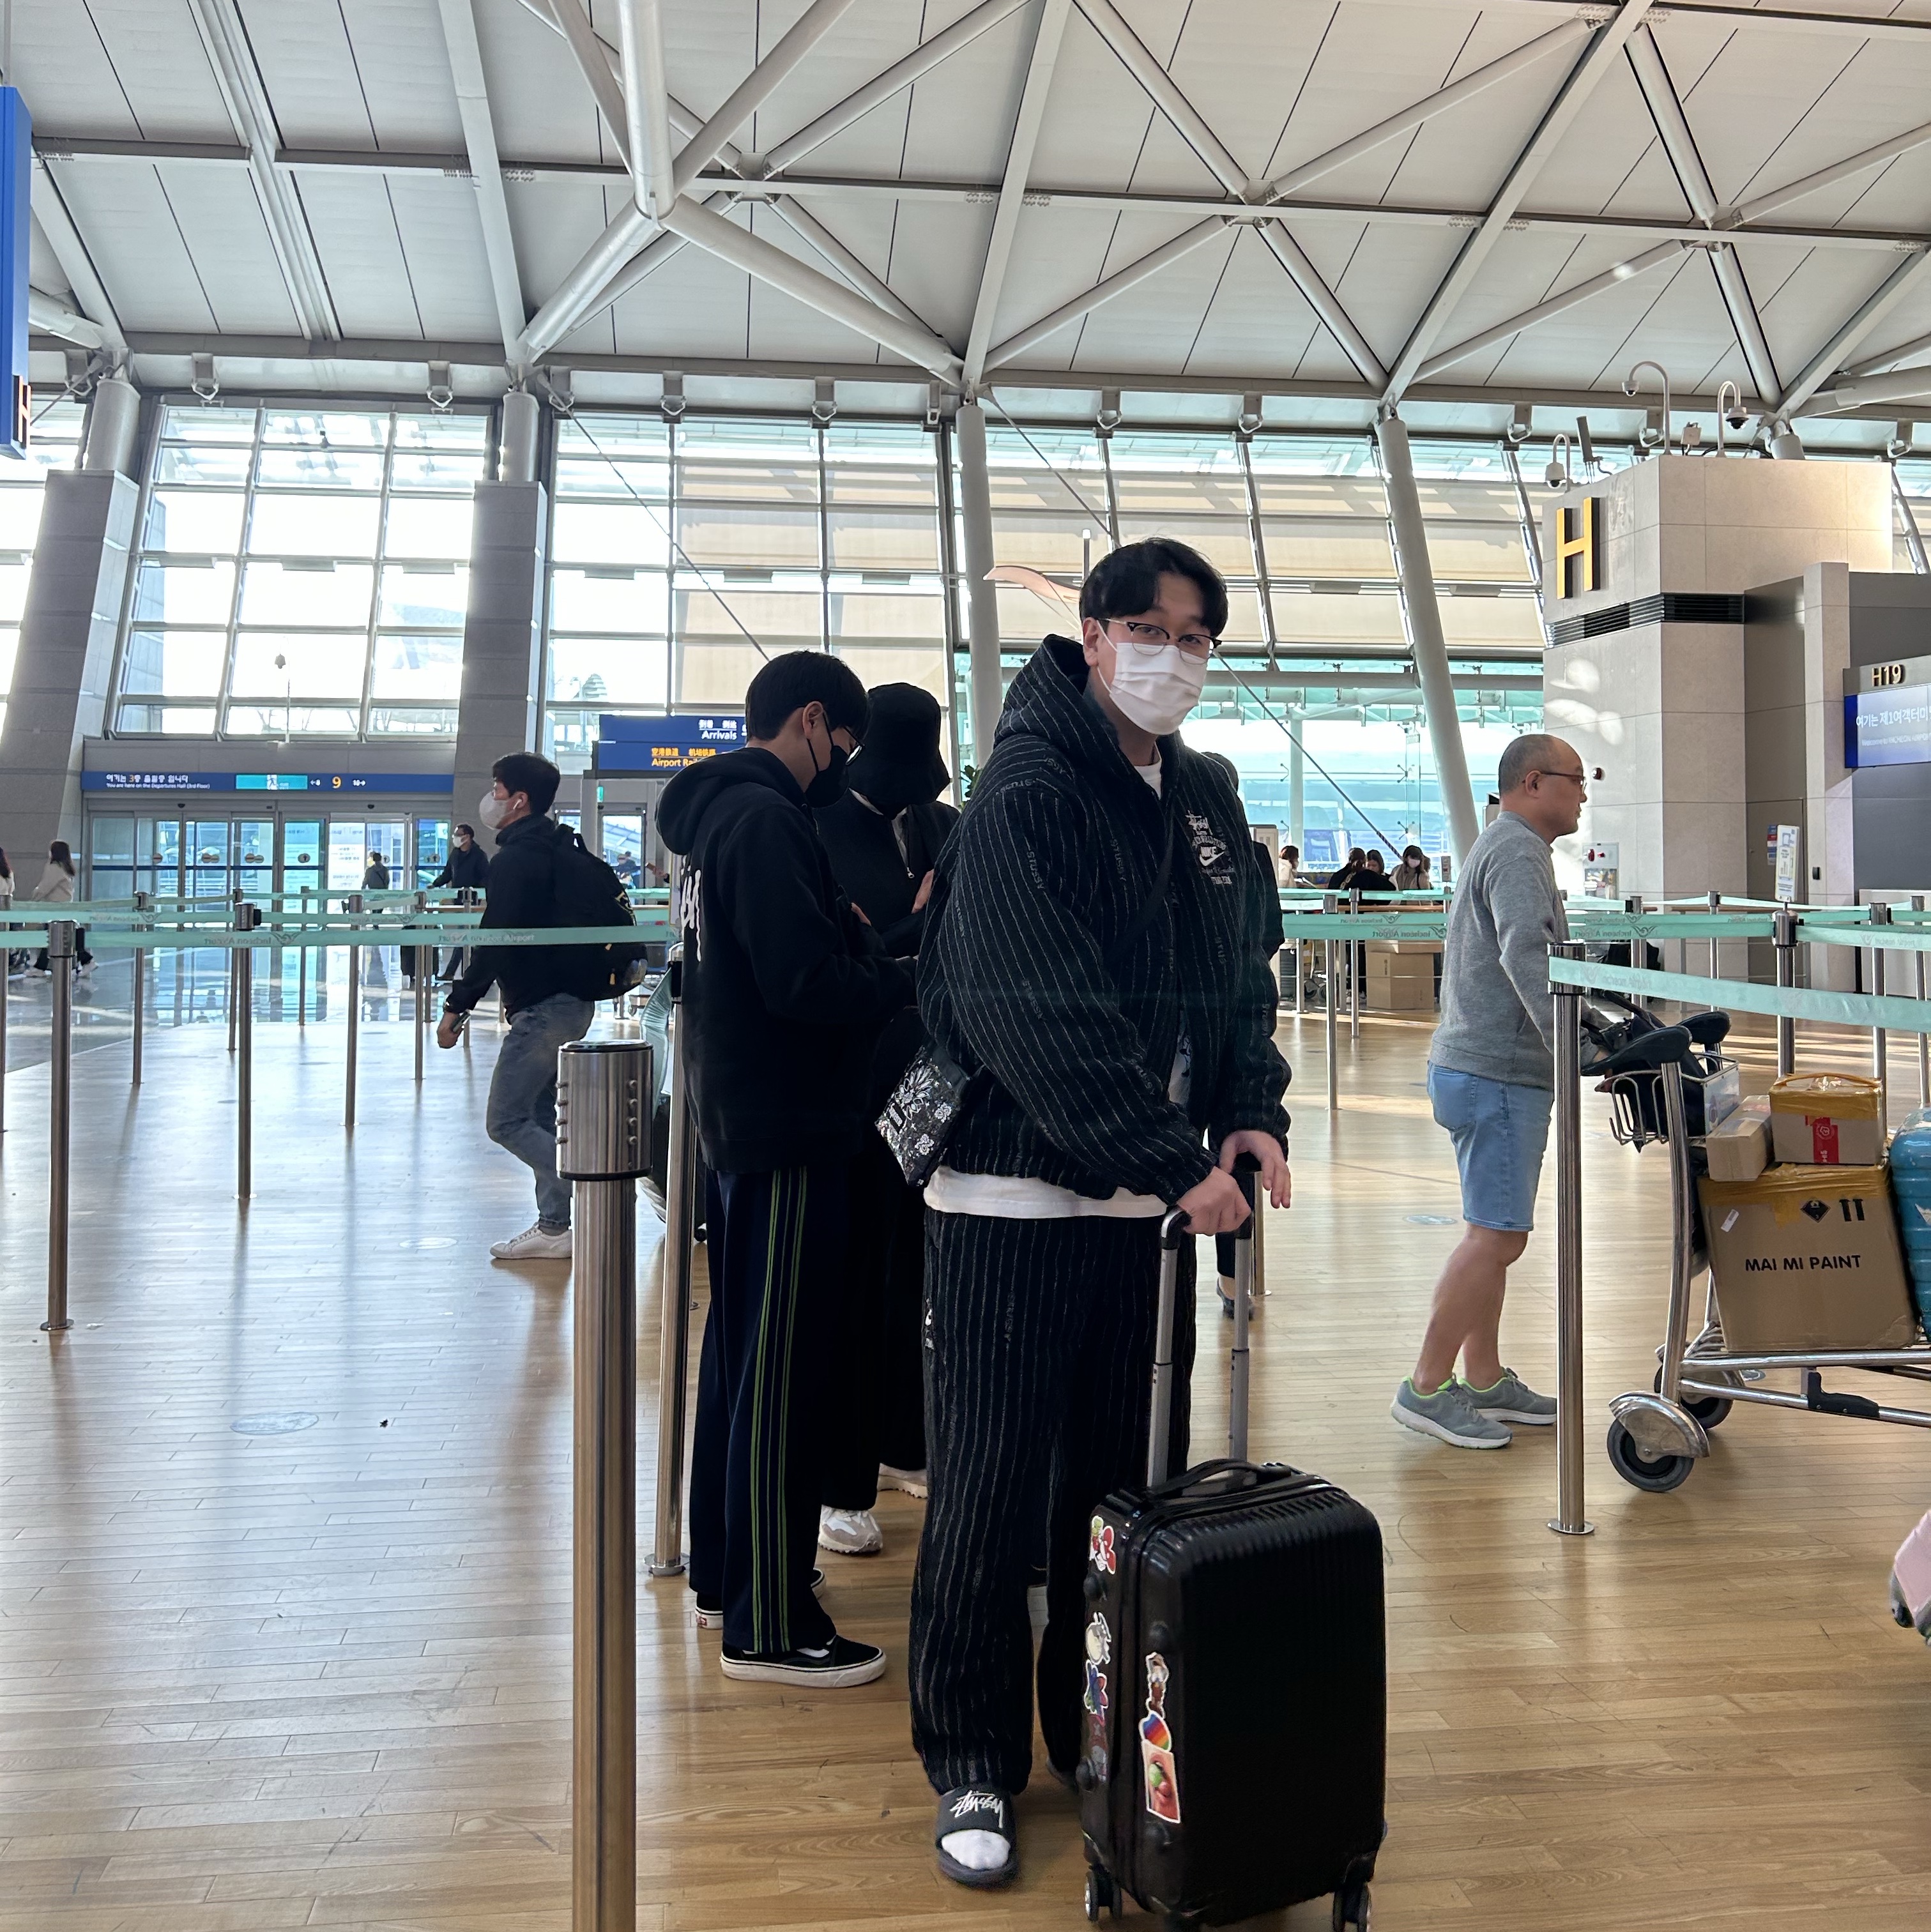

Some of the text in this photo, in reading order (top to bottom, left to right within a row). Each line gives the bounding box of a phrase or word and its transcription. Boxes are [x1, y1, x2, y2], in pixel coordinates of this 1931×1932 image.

[1557, 497, 1596, 599] H
[1872, 664, 1902, 687] H19
[1856, 705, 1931, 728] 여기는 제1여객터미
[701, 730, 737, 740] Arrivals
[652, 757, 681, 768] Airport
[332, 775, 342, 789] 9
[1745, 1254, 1861, 1271] MAI MI PAINT
